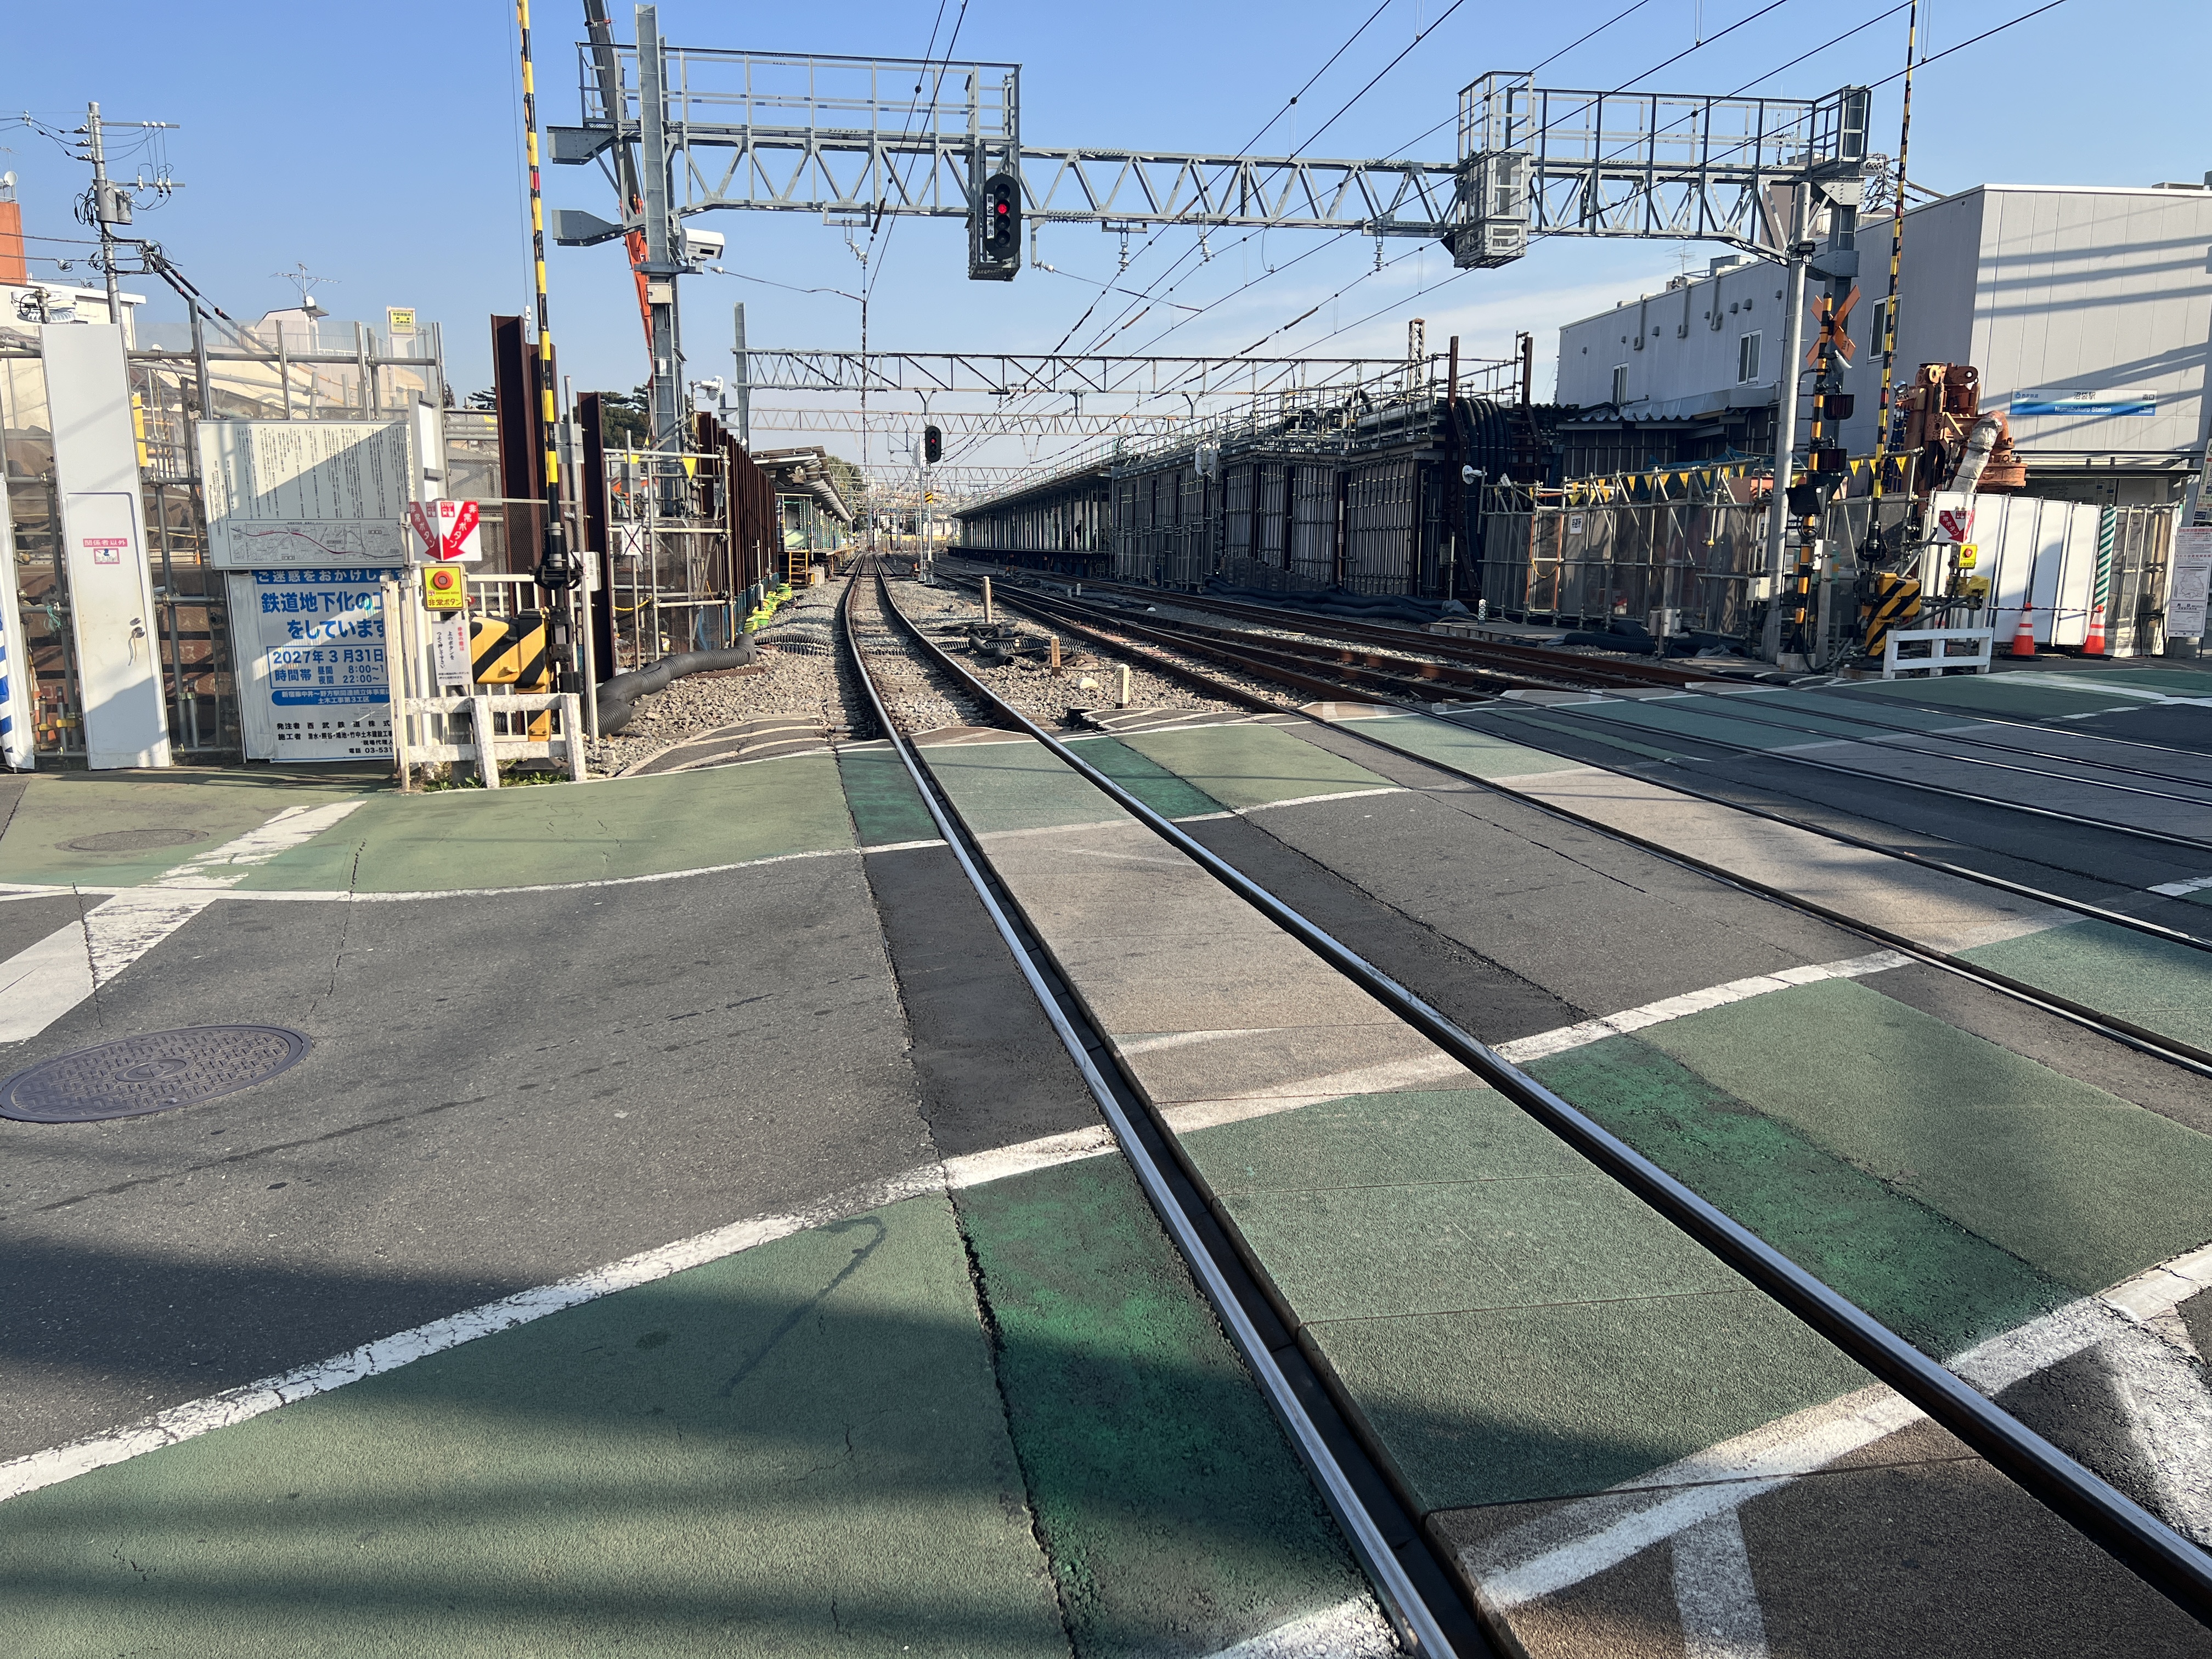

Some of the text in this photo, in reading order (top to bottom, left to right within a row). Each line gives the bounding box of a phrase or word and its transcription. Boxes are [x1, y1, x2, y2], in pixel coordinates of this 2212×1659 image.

[2074, 392, 2096, 400] 沼袋駅
[449, 504, 476, 548] 非常ボタン
[318, 666, 333, 674] 昼間
[275, 669, 312, 681] 時間帯
[319, 676, 334, 684] 夜間
